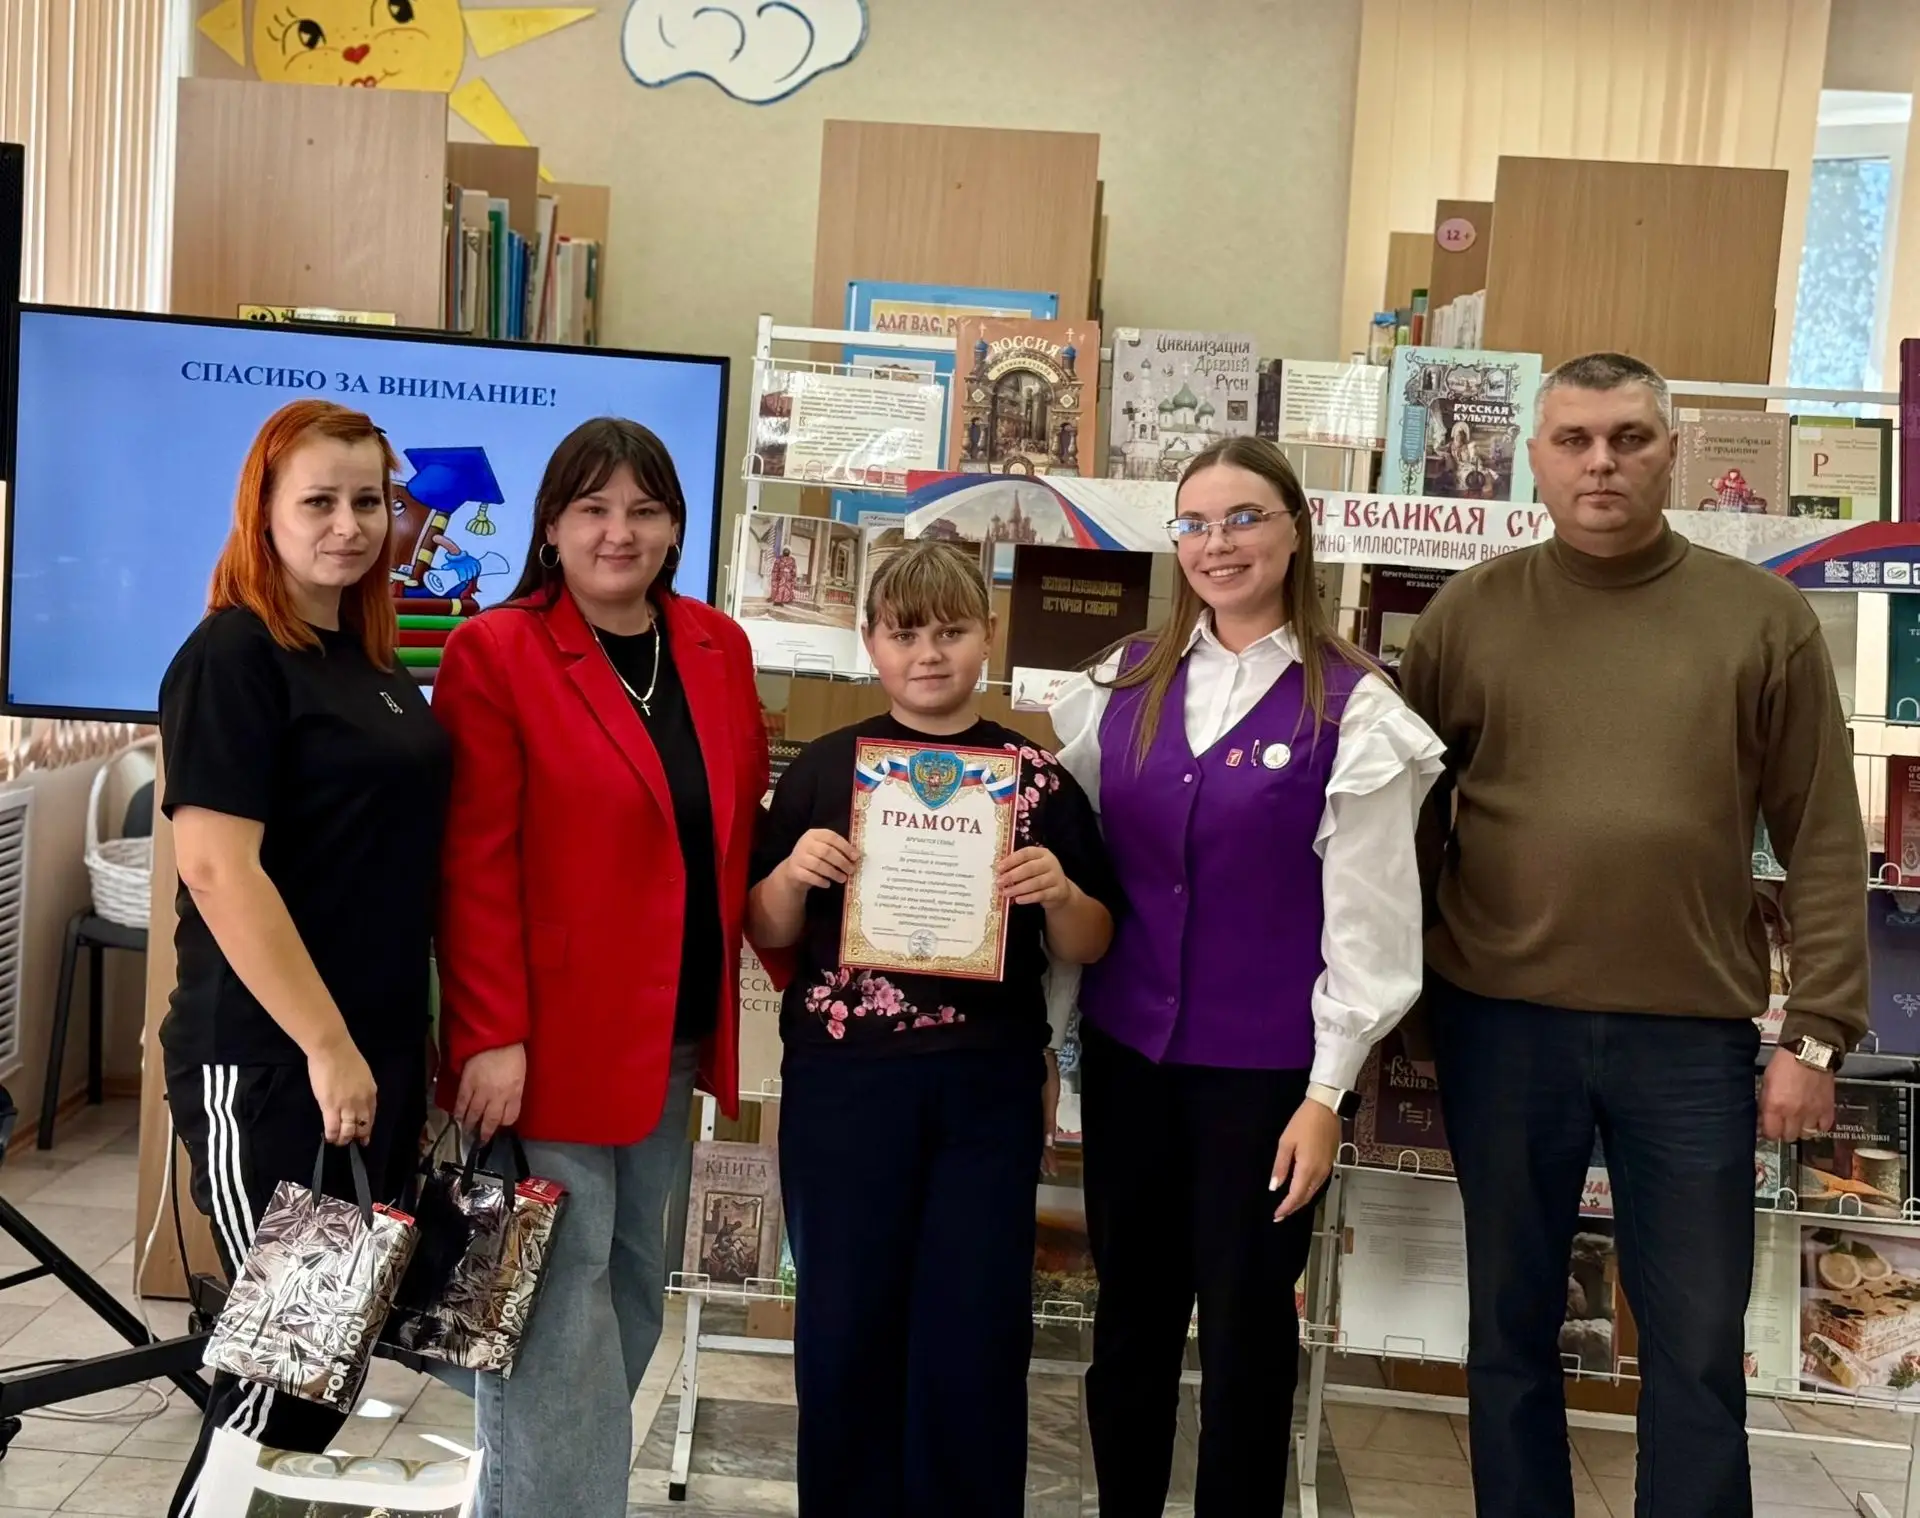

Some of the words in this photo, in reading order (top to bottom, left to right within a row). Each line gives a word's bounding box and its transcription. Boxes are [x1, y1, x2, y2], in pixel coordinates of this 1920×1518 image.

[875, 312, 908, 332] ДЛЯ
[911, 314, 942, 335] ВАС,
[989, 335, 1062, 358] РОССИЯ
[1156, 334, 1251, 357] Цивилизация
[181, 360, 327, 391] СПАСИБО
[335, 371, 370, 394] ЗА
[378, 374, 557, 408] ВНИМАНИЕ!
[1215, 373, 1249, 396] Руси
[1453, 403, 1510, 415] РУССКАЯ
[1453, 412, 1508, 425] КУЛЬТУРА
[1506, 509, 1549, 540] СУ
[881, 809, 983, 835] ГРАМОТА
[1835, 1123, 1865, 1133] БЛЮДА
[704, 1160, 767, 1178] КНИГА
[497, 1290, 521, 1328] YOU
[322, 1361, 351, 1404] FOR
[339, 1315, 367, 1356] YOU
[488, 1332, 510, 1370] FOR
